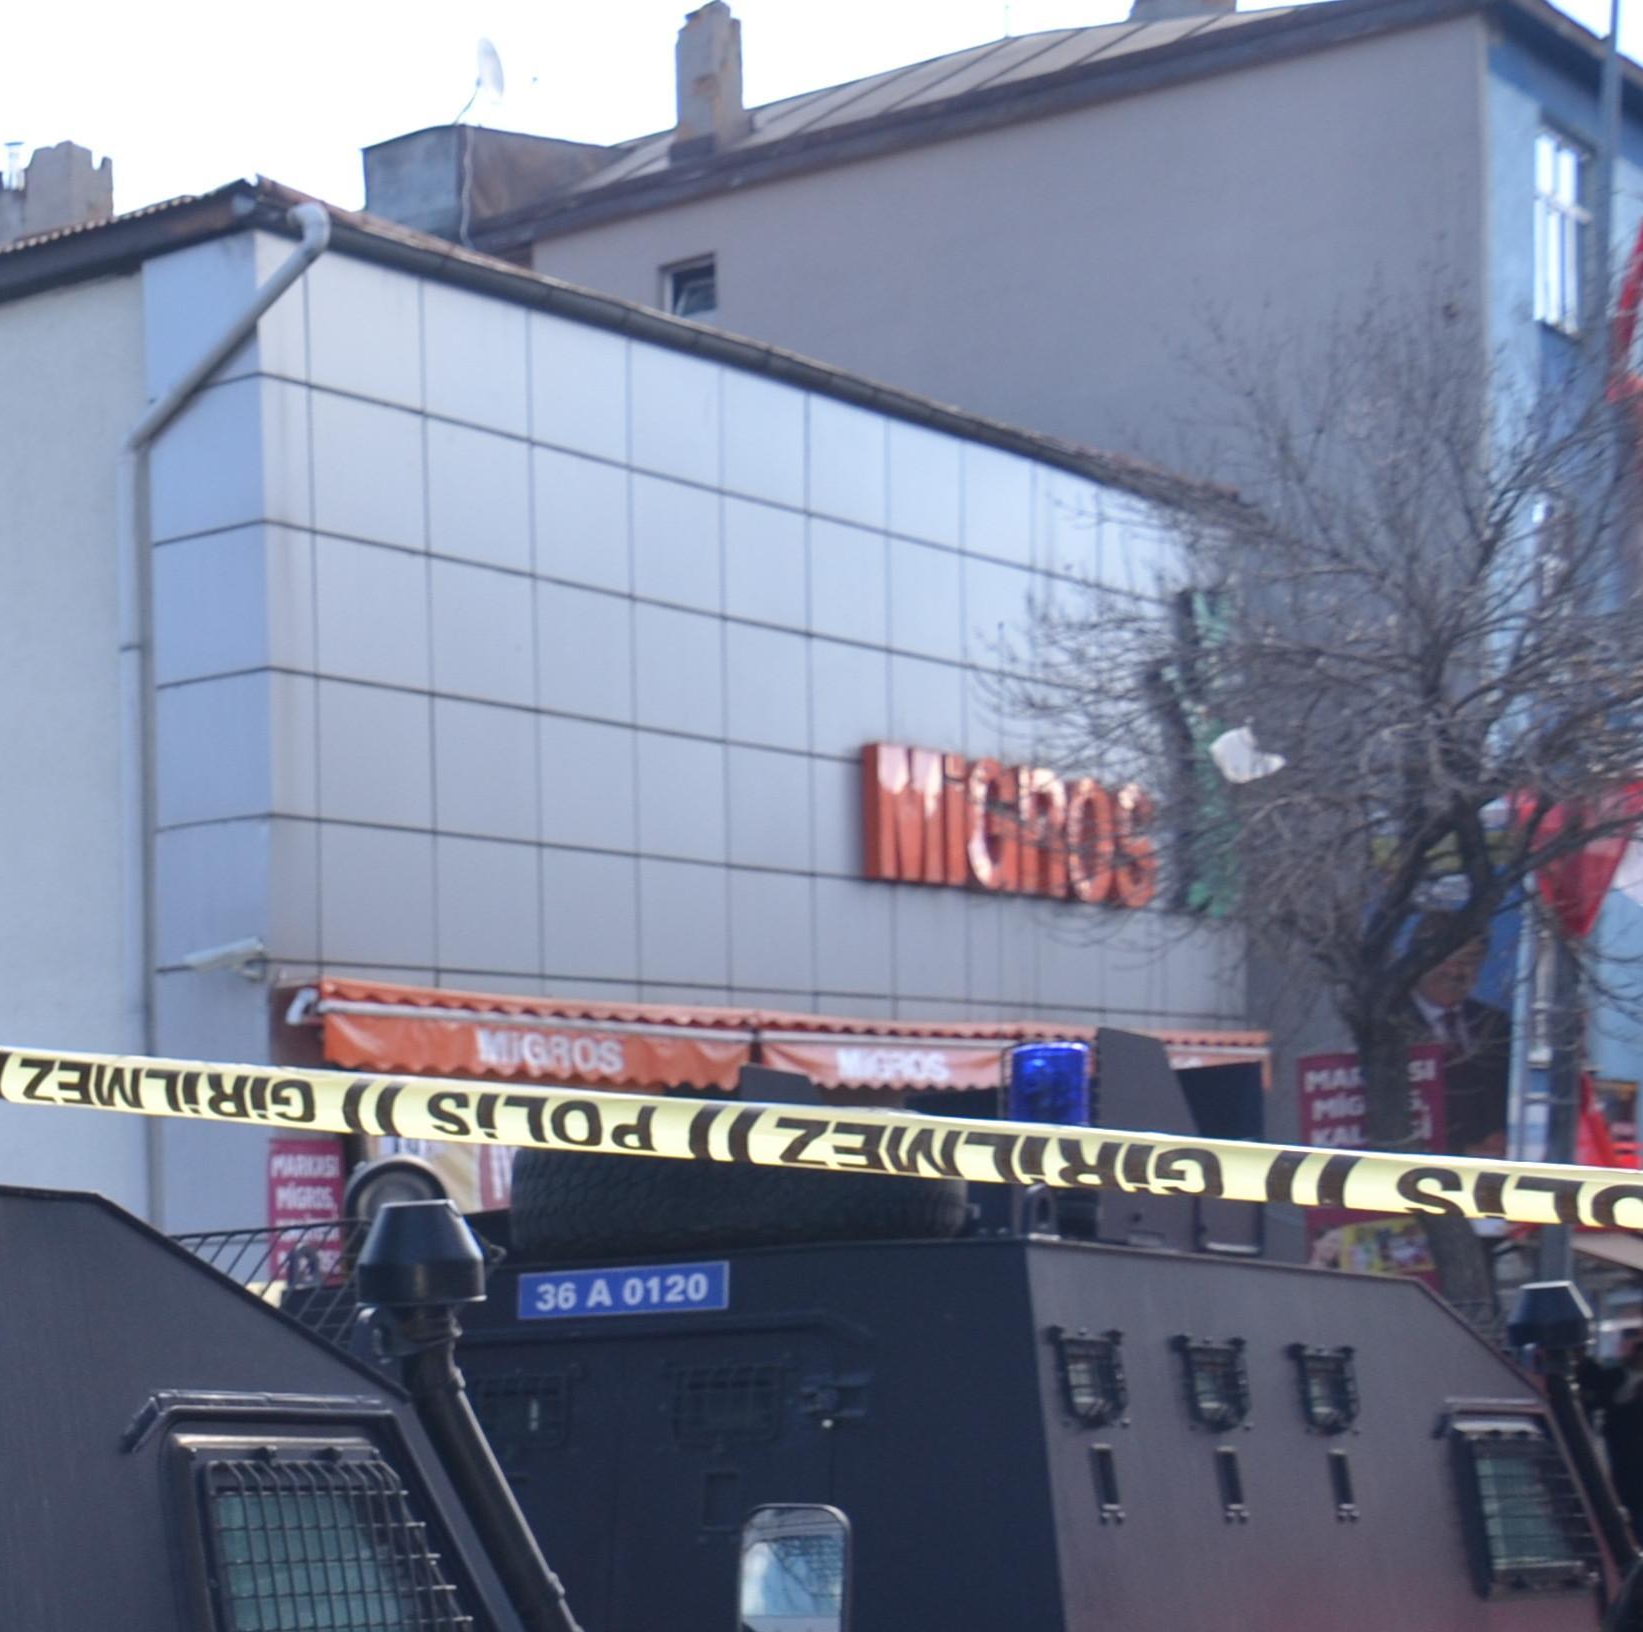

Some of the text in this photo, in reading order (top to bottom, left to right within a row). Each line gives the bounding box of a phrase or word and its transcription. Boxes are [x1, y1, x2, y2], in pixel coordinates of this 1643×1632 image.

[1396, 1166, 1643, 1230] OLİS
[535, 1273, 709, 1311] 36 A 0120
